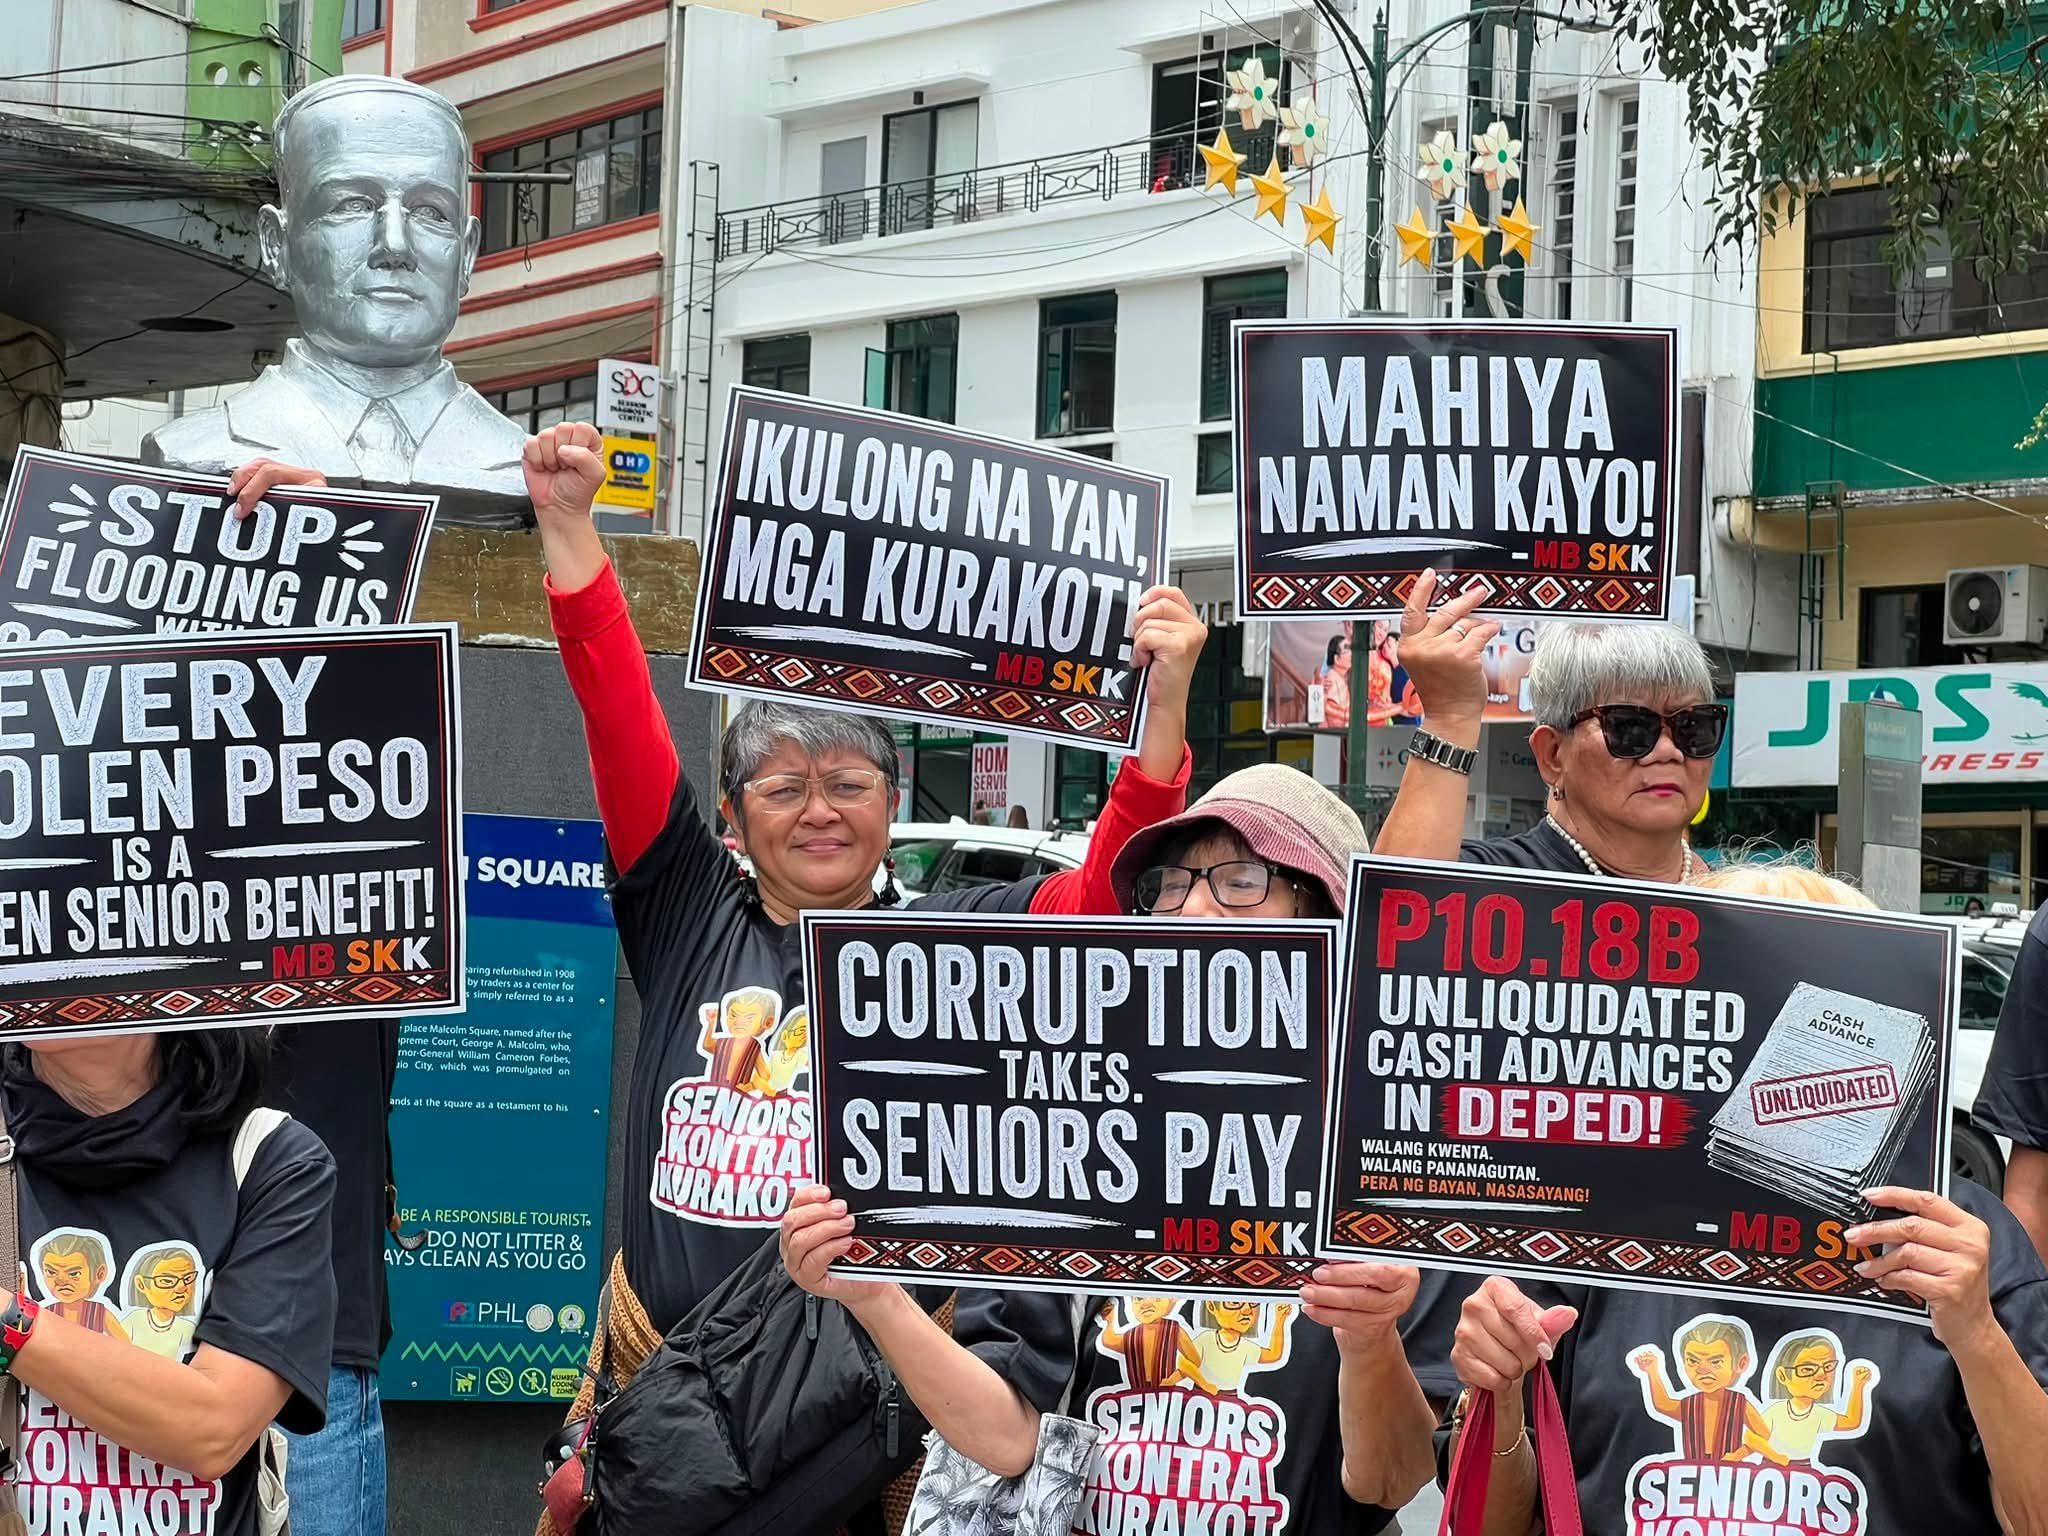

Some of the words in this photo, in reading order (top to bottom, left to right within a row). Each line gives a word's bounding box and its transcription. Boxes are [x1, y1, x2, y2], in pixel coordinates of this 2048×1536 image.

[1301, 355, 1614, 451] MAHIYA
[615, 454, 645, 468] BHF
[735, 418, 954, 532] IKULONG
[964, 458, 1031, 546] NA
[1046, 473, 1148, 577] YAN,
[1258, 453, 1475, 534] NAMAN
[1493, 454, 1657, 537] KAYO!
[100, 483, 338, 566] STOP
[1533, 540, 1580, 569] MB
[1587, 543, 1652, 573] SKK
[15, 535, 301, 627] FLOODING
[314, 575, 388, 627] US
[722, 515, 845, 618] MGA
[862, 536, 1144, 664] KURAKOT!
[994, 651, 1046, 686] MB
[1049, 658, 1128, 701] SKK
[0, 655, 328, 749] EVERY
[974, 746, 1008, 773] HOM
[1921, 751, 2045, 772] RESS
[0, 747, 194, 839] OLEN
[225, 736, 429, 827] PESO
[112, 837, 152, 882] IS
[167, 835, 193, 879] A
[477, 856, 605, 889] SQUARE
[0, 890, 52, 956] EN
[67, 881, 230, 953] SENIOR
[245, 867, 435, 940] BENEFIT!
[1376, 886, 1701, 983] P10.18B
[272, 943, 336, 979] MB
[346, 936, 434, 974] SKK
[493, 966, 541, 977] refurbished
[543, 968, 551, 977] in
[555, 969, 575, 979] 1908
[467, 978, 478, 987] by
[481, 979, 511, 988] traders
[532, 982, 560, 990] center
[562, 981, 574, 991] for
[473, 990, 502, 1001] simply
[505, 991, 539, 1001] referred
[543, 993, 552, 1002] to
[555, 995, 565, 1003] as
[837, 940, 1308, 1050] CORRUPTION
[1378, 973, 1747, 1042] UNLIQUIDATED
[1822, 1008, 1865, 1031] CASH
[404, 1023, 428, 1034] place
[429, 1024, 467, 1035] Malcolm
[503, 1028, 533, 1038] named
[535, 1029, 556, 1039] after
[557, 1030, 572, 1039] the
[461, 1038, 494, 1049] George
[550, 1042, 572, 1052] who,
[1807, 1018, 1876, 1050] ADVANCE
[414, 1061, 434, 1071] City,
[440, 1062, 467, 1071] which
[472, 1064, 490, 1072] was
[496, 1065, 553, 1076] promulgated
[558, 1067, 570, 1075] on
[458, 1050, 491, 1060] William
[495, 1051, 535, 1062] Cameron
[540, 1053, 571, 1065] Forbes,
[999, 1049, 1143, 1103] TAKES.
[1367, 1029, 1483, 1080] CASH
[1497, 1035, 1734, 1092] ADVANCES
[389, 1097, 411, 1106] ands
[413, 1098, 423, 1106] at
[425, 1098, 441, 1107] the
[443, 1100, 473, 1109] square
[497, 1101, 540, 1111] testament
[543, 1103, 553, 1111] to
[556, 1103, 569, 1112] his
[670, 1086, 812, 1140] SENIORS
[1383, 1083, 1432, 1134] IN
[1457, 1085, 1663, 1144] DEPED!
[1759, 1074, 1890, 1115] UNLIQUIDATED
[667, 1124, 802, 1178] KONTRA
[842, 1097, 1139, 1204] SENIORS
[1165, 1111, 1312, 1208] PAY.
[1360, 1156, 1422, 1175] WALANG
[1426, 1160, 1541, 1182] PANANAGUTAN.
[1361, 1138, 1423, 1157] WALANG
[1427, 1141, 1494, 1161] KWENTA.
[1359, 1174, 1398, 1192] PERA
[1403, 1177, 1424, 1193] NG
[1428, 1178, 1481, 1198] BAYAN,
[1485, 1181, 1590, 1203] NASASAYANG!
[400, 1208, 417, 1222] BE
[420, 1209, 431, 1222] A
[435, 1210, 527, 1225] RESPONSIBLE
[1162, 1216, 1219, 1253] MB
[1229, 1218, 1310, 1257] SKK
[1729, 1210, 1801, 1254] MB
[383, 1249, 414, 1267] AYS
[419, 1250, 481, 1268] CLEAN
[486, 1251, 510, 1269] AS
[513, 1252, 552, 1270] YOU
[557, 1253, 586, 1270] GO
[427, 1230, 457, 1248] DO
[461, 1231, 501, 1249] NOT
[505, 1232, 565, 1250] LITTER
[569, 1234, 583, 1251] &
[478, 1302, 524, 1323] PHL
[1096, 1391, 1273, 1458] SENIORS
[1087, 1442, 1263, 1505] KONTRA
[17, 1486, 210, 1536] URAKOT
[1073, 1487, 1276, 1536] KURAKOT
[1638, 1465, 1852, 1535] SENIORS
